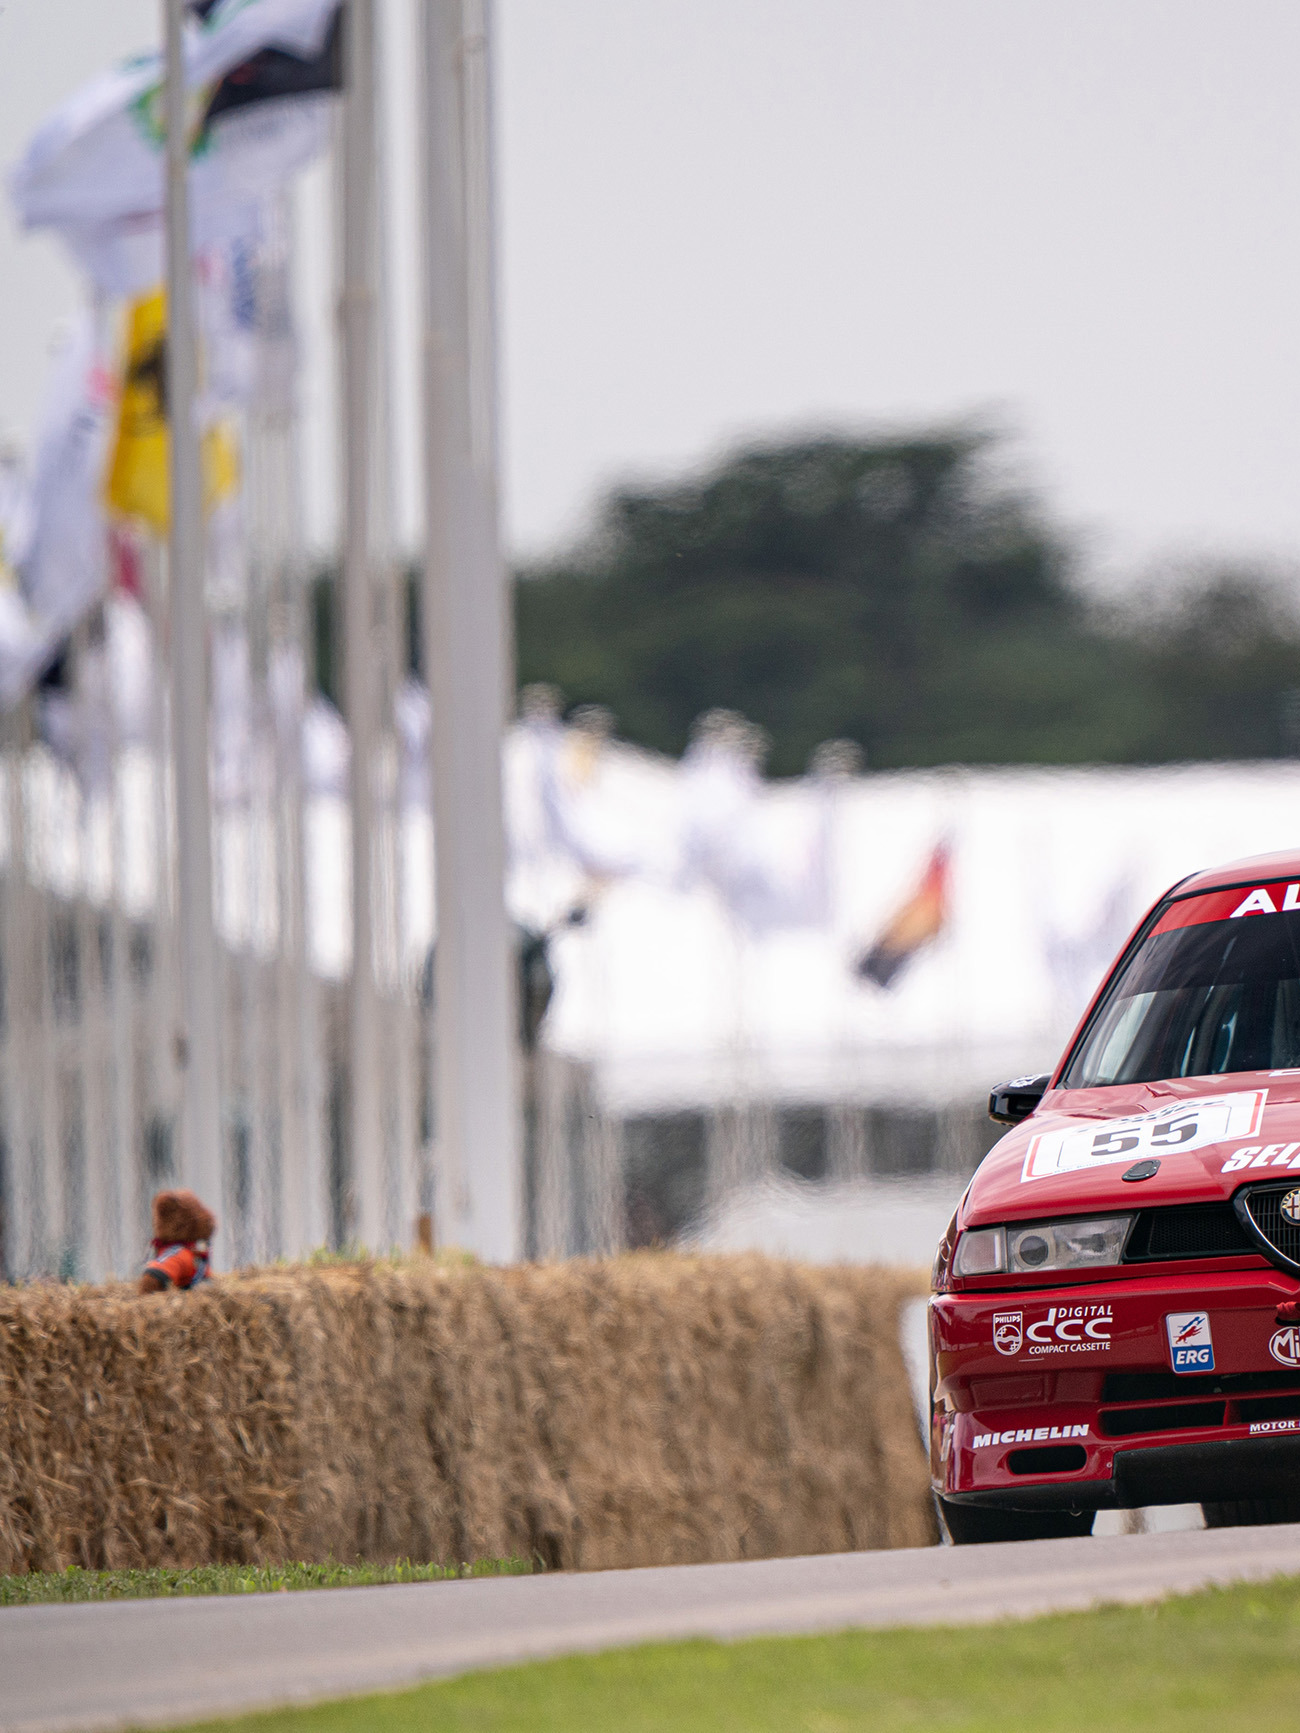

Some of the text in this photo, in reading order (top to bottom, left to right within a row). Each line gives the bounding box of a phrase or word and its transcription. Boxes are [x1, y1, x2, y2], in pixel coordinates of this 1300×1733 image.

[1091, 1113, 1199, 1156] 55
[1058, 1305, 1113, 1318] DIGITAL
[995, 1315, 1021, 1324] PHILIPS
[1028, 1342, 1111, 1355] COMPACT CASSETTE
[1176, 1348, 1209, 1365] ERG
[1249, 1420, 1295, 1432] MOTOR
[972, 1424, 1090, 1449] MICHELIN
